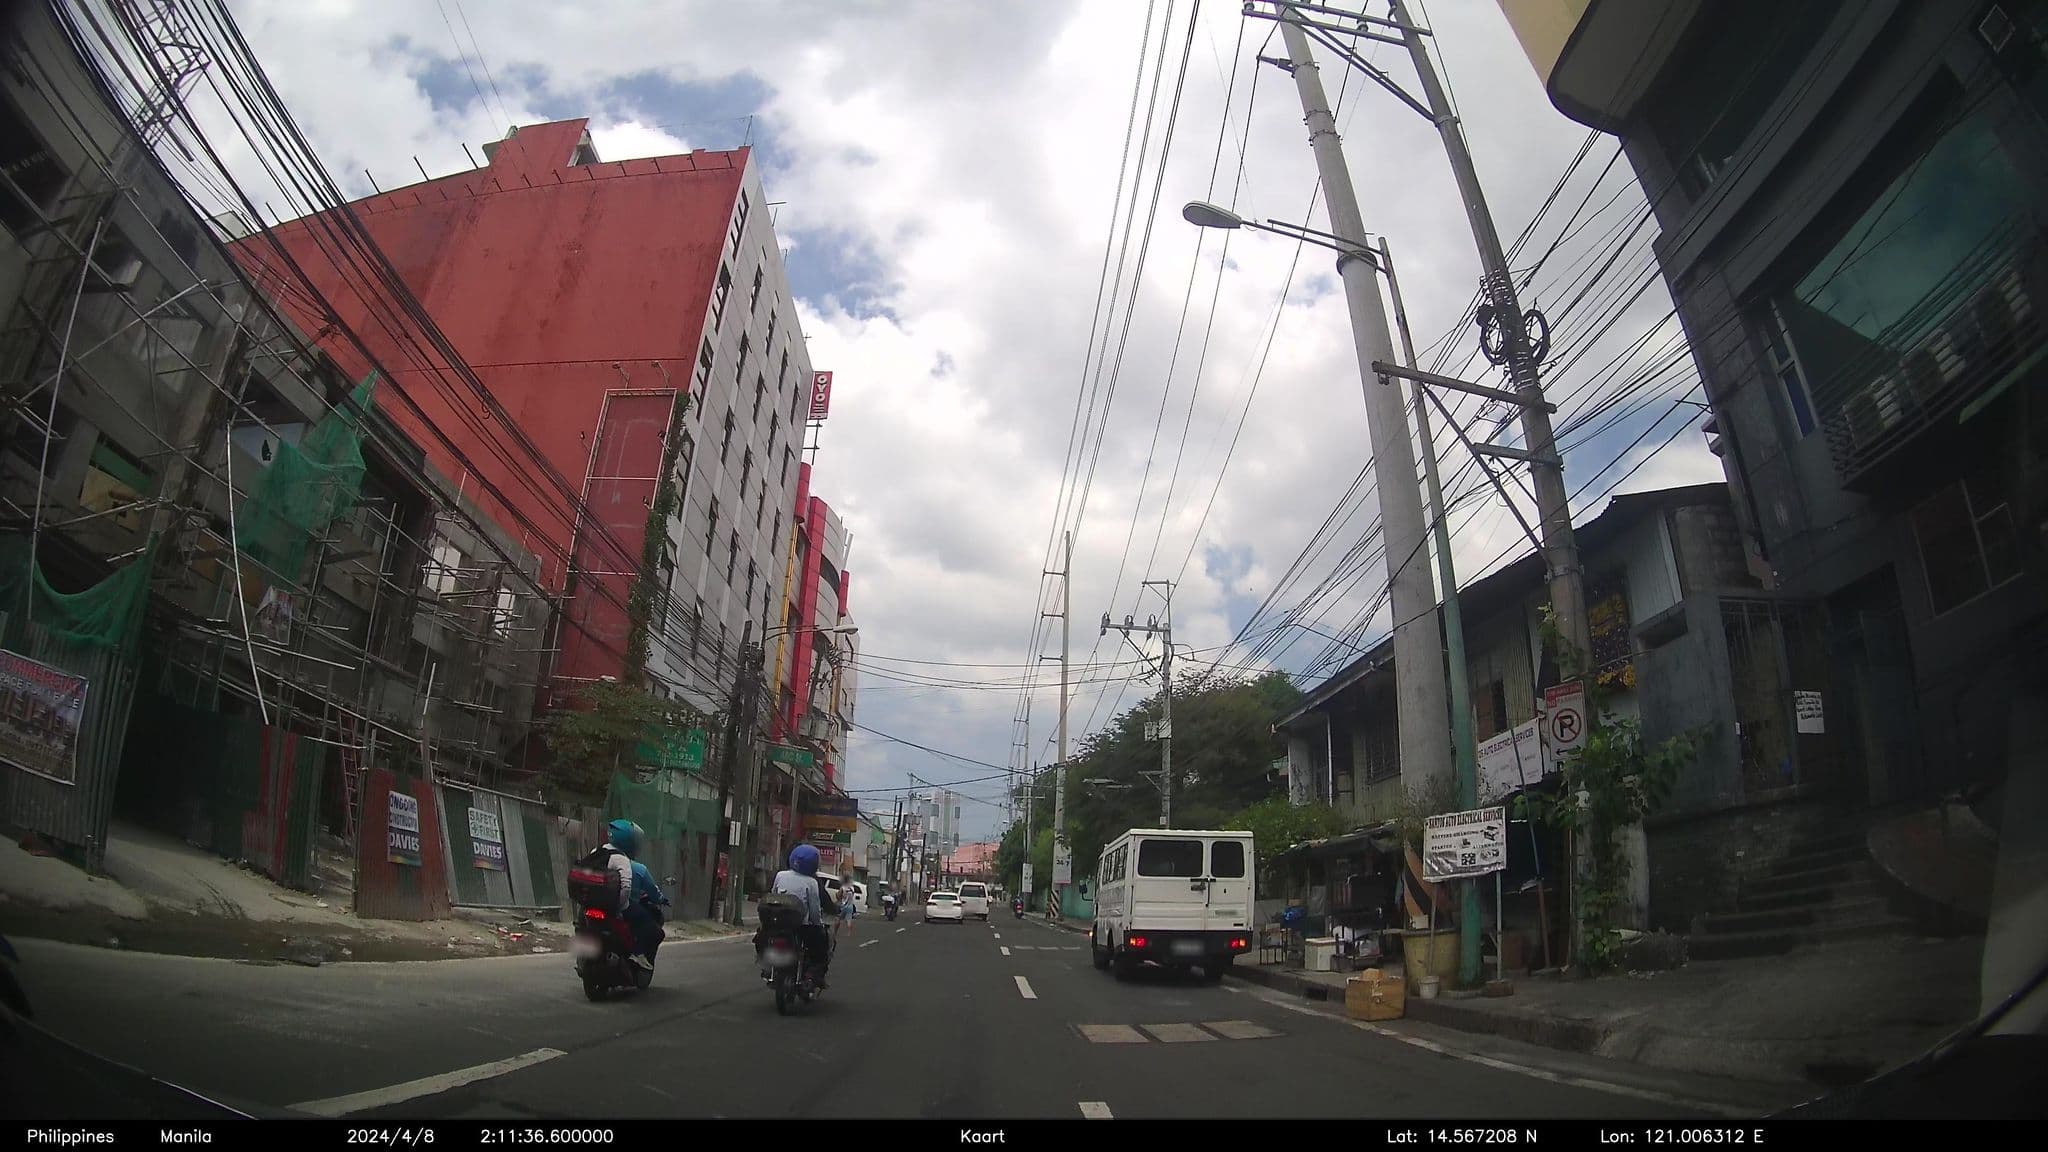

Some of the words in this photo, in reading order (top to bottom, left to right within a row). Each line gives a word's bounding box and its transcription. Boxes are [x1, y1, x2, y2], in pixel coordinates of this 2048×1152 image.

[816, 374, 828, 403] OYO
[469, 809, 498, 827] SAFETY
[389, 832, 420, 852] DAVIES
[473, 841, 502, 859] DAVIES
